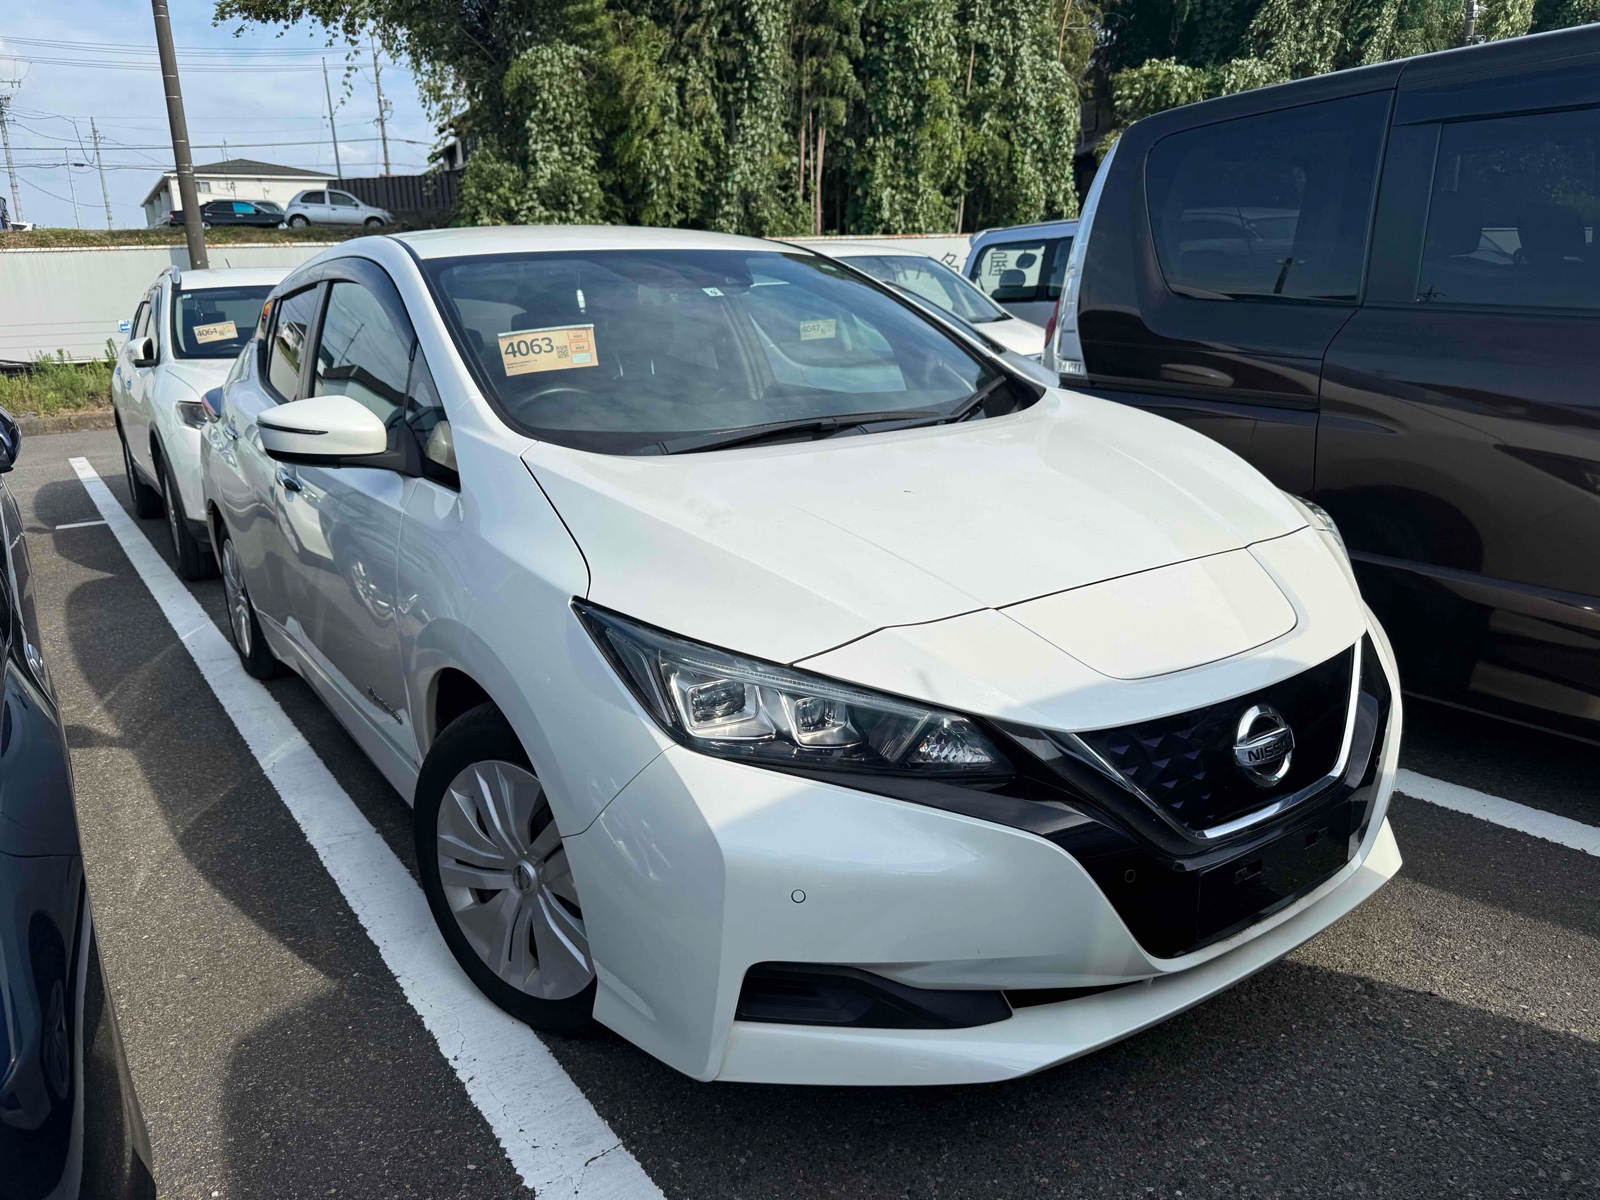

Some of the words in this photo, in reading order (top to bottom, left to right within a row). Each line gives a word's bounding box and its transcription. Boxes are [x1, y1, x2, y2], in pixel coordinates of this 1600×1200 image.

[196, 327, 218, 338] 4064
[504, 337, 555, 358] 4063
[1248, 740, 1291, 763] NISSA
